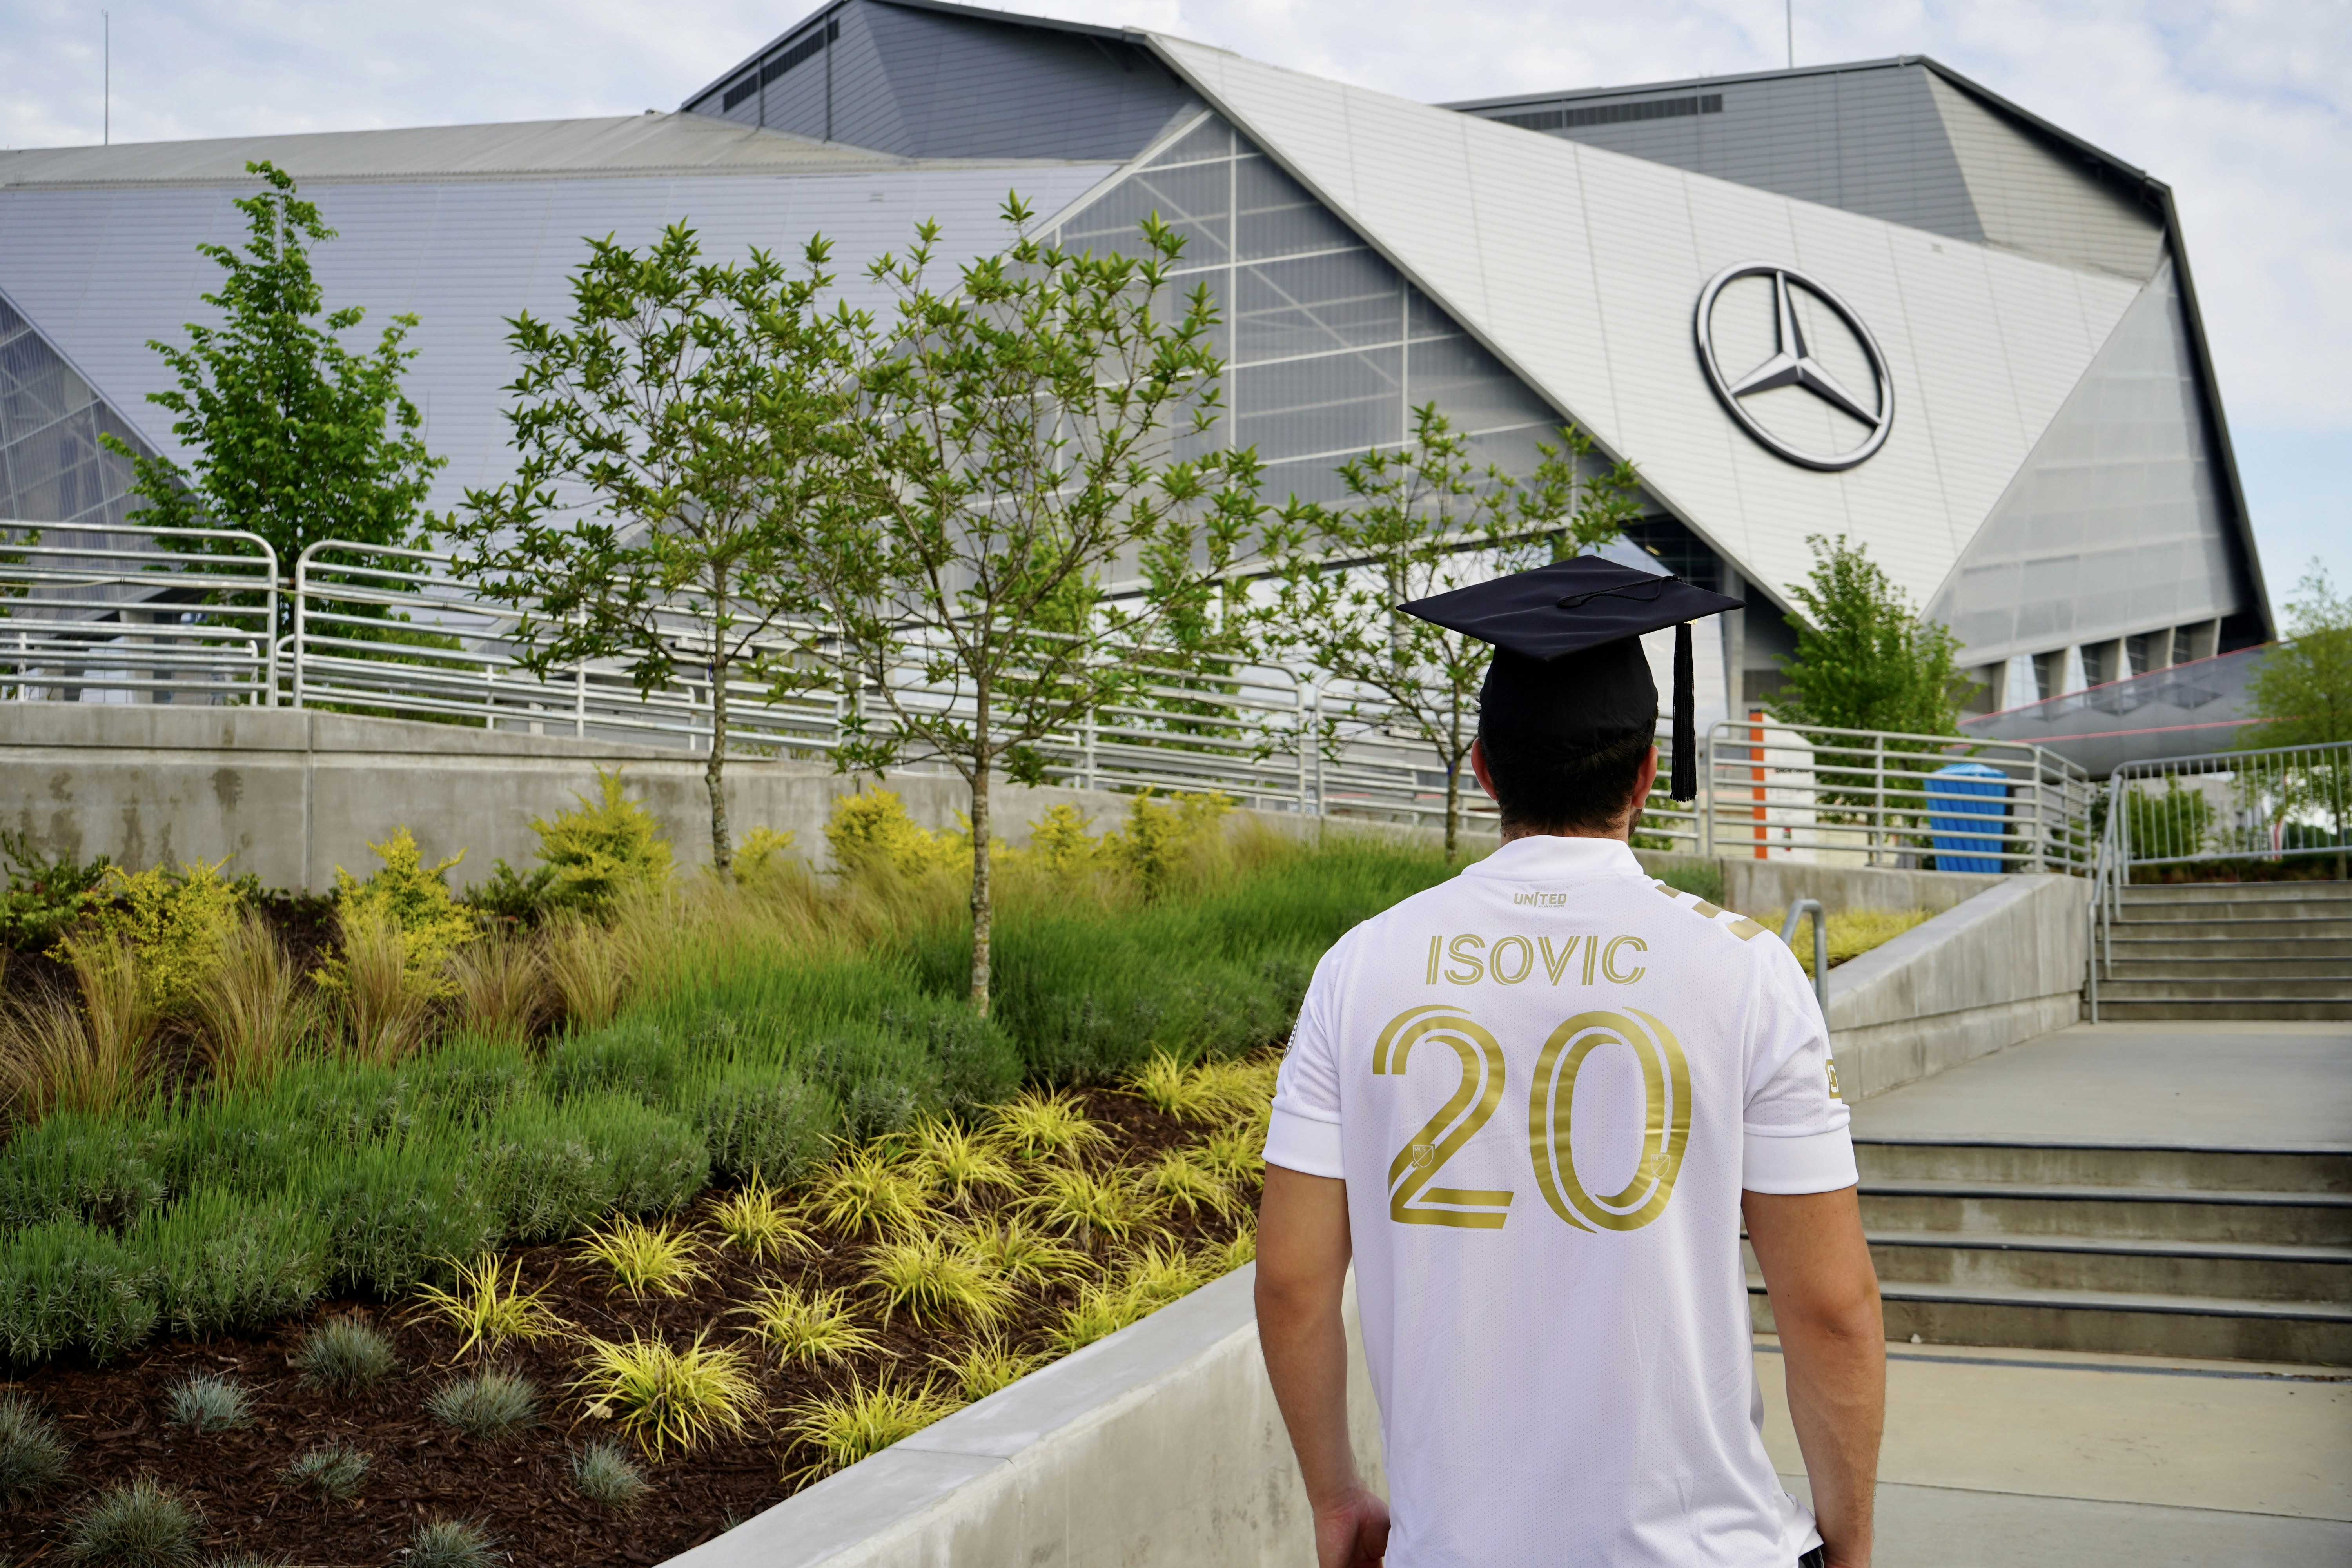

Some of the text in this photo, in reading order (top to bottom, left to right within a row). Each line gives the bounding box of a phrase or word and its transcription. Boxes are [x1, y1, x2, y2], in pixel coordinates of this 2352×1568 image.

[1514, 891, 1567, 907] UNITED
[1426, 933, 1648, 986] ISOVIC
[1372, 1004, 1692, 1234] 20
